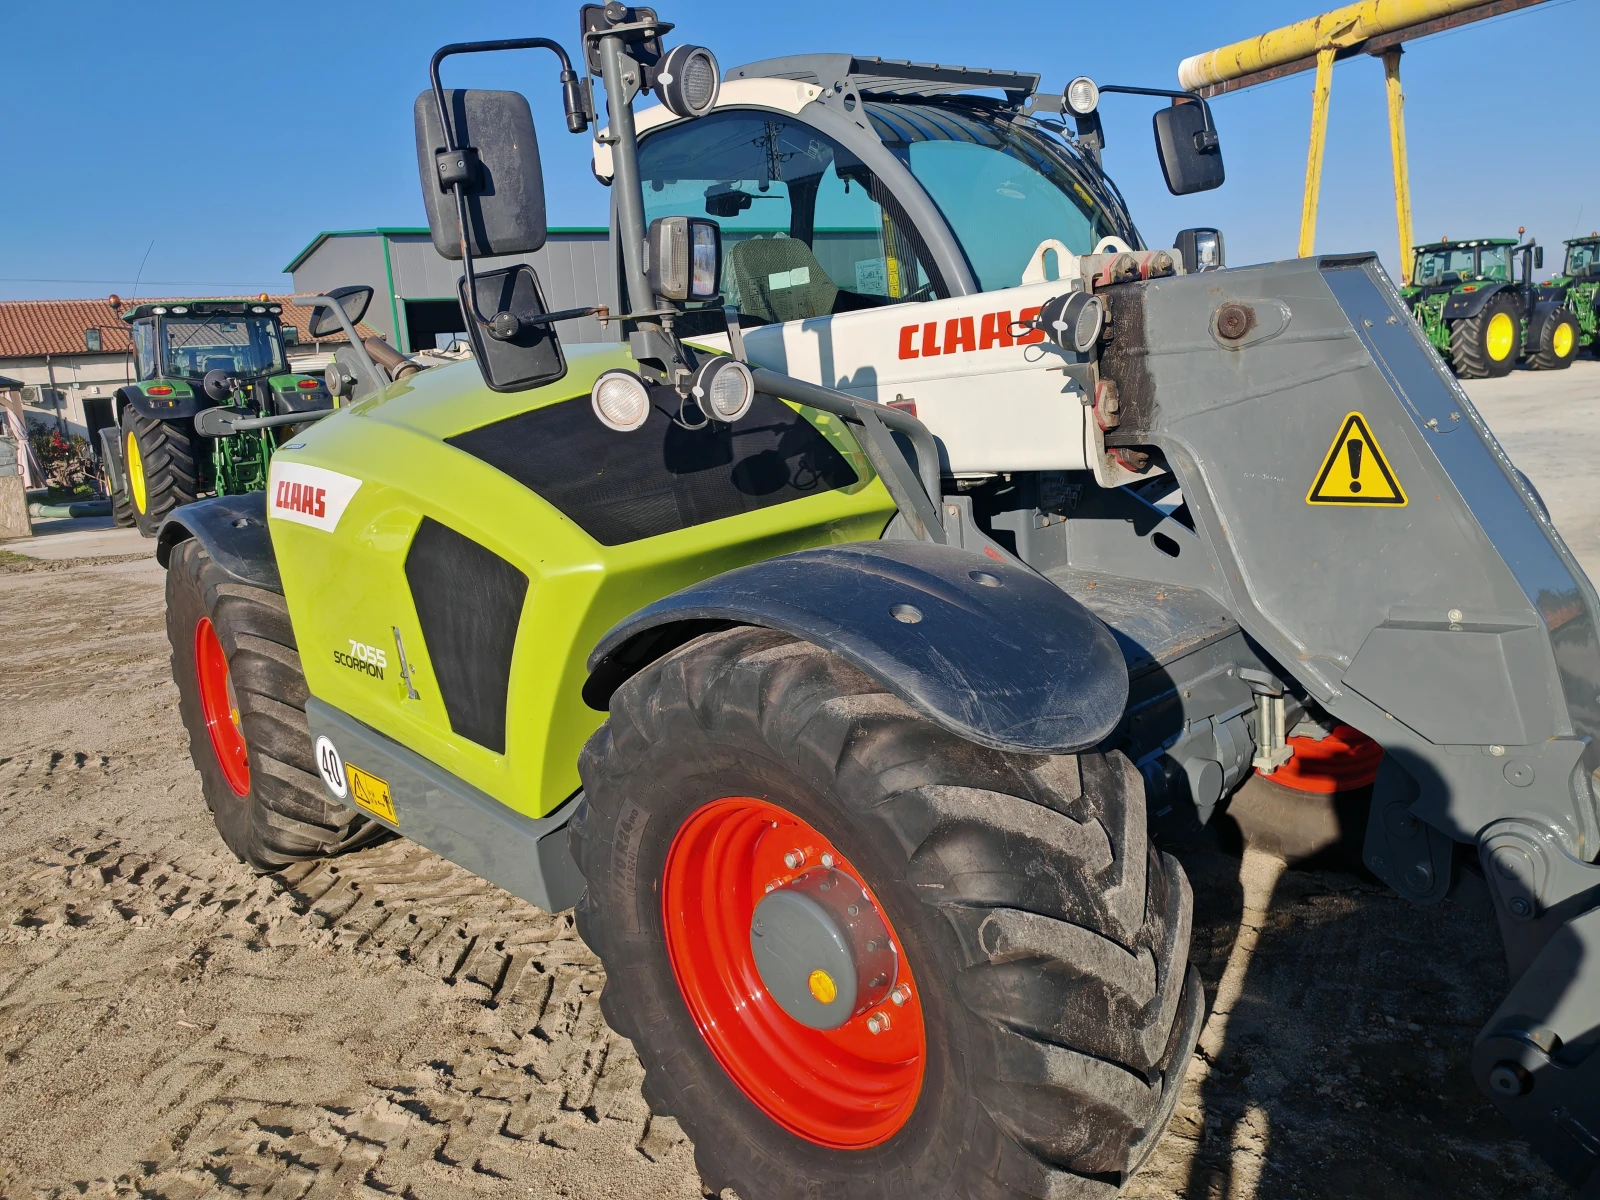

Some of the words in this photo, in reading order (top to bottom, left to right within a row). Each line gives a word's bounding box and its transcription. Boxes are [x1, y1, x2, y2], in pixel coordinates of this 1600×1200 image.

[899, 306, 1046, 360] CLAAS
[275, 481, 326, 518] CLAAS
[334, 650, 384, 680] SCORPION
[349, 639, 387, 668] 7055
[322, 745, 343, 787] 40
